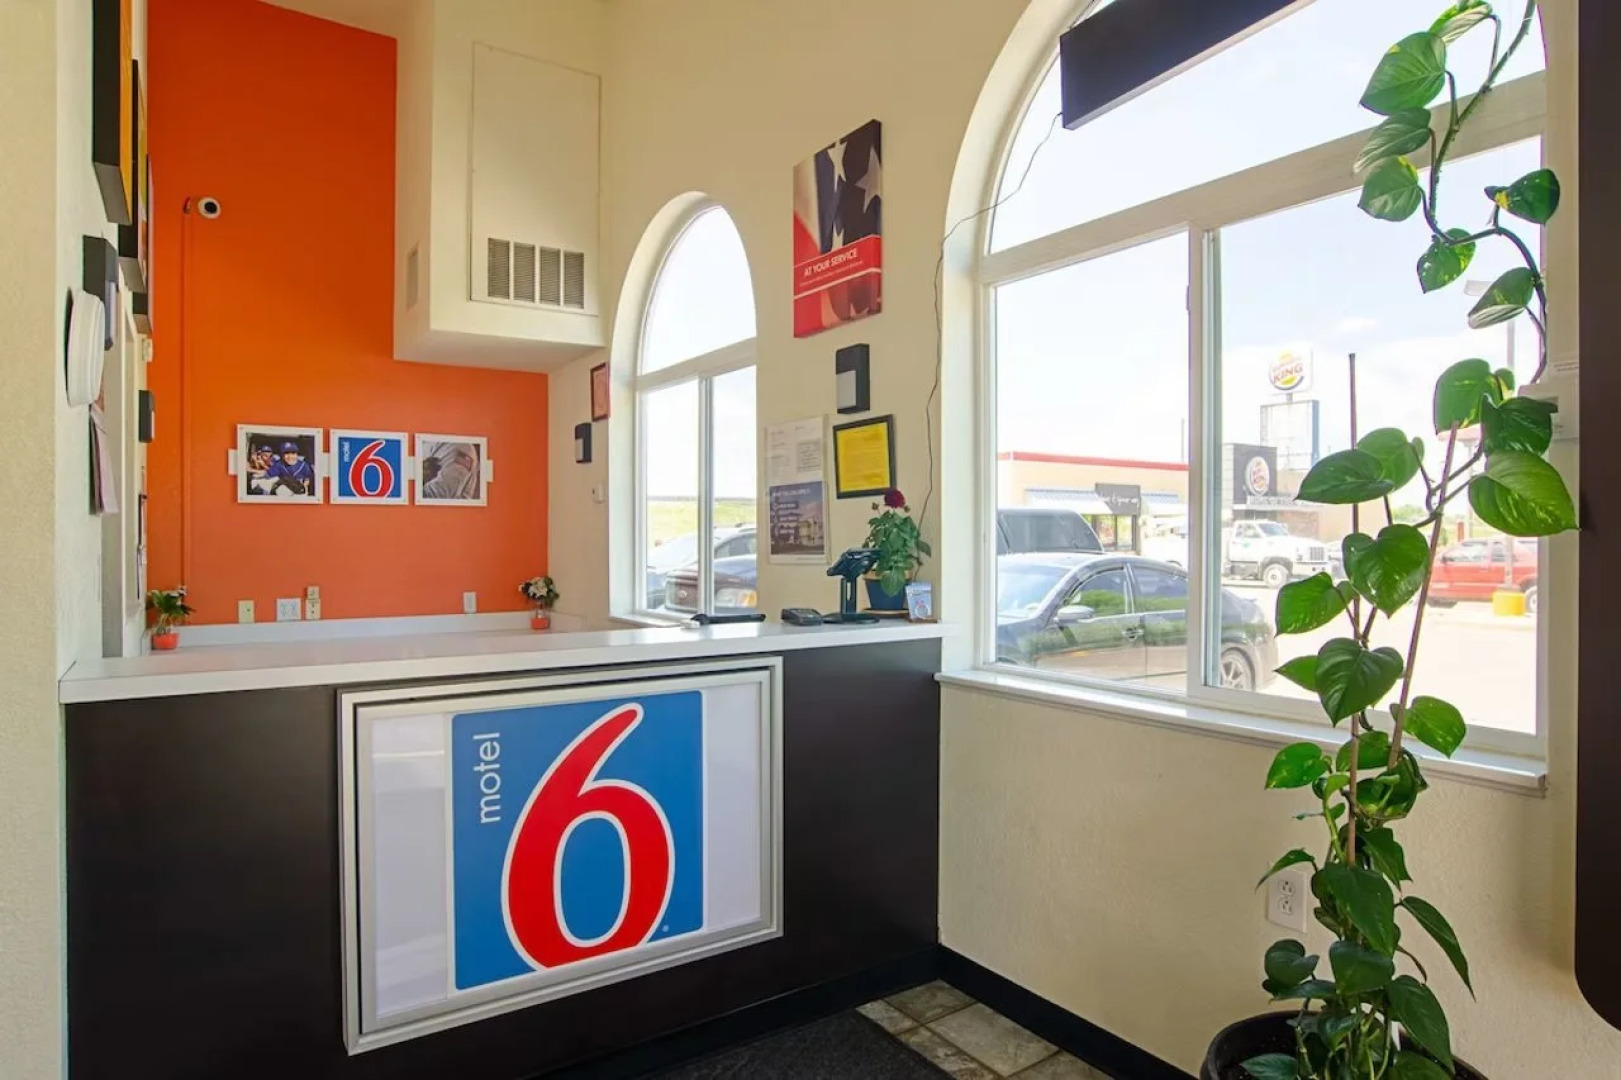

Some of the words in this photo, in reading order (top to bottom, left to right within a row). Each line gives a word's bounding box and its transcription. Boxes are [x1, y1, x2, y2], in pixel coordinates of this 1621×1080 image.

[803, 266, 813, 277] AT
[813, 259, 831, 273] YOUR
[831, 248, 858, 266] SERVICE
[1272, 362, 1304, 385] KING
[348, 440, 395, 498] 6
[473, 732, 501, 825] motel
[501, 702, 676, 972] 6
